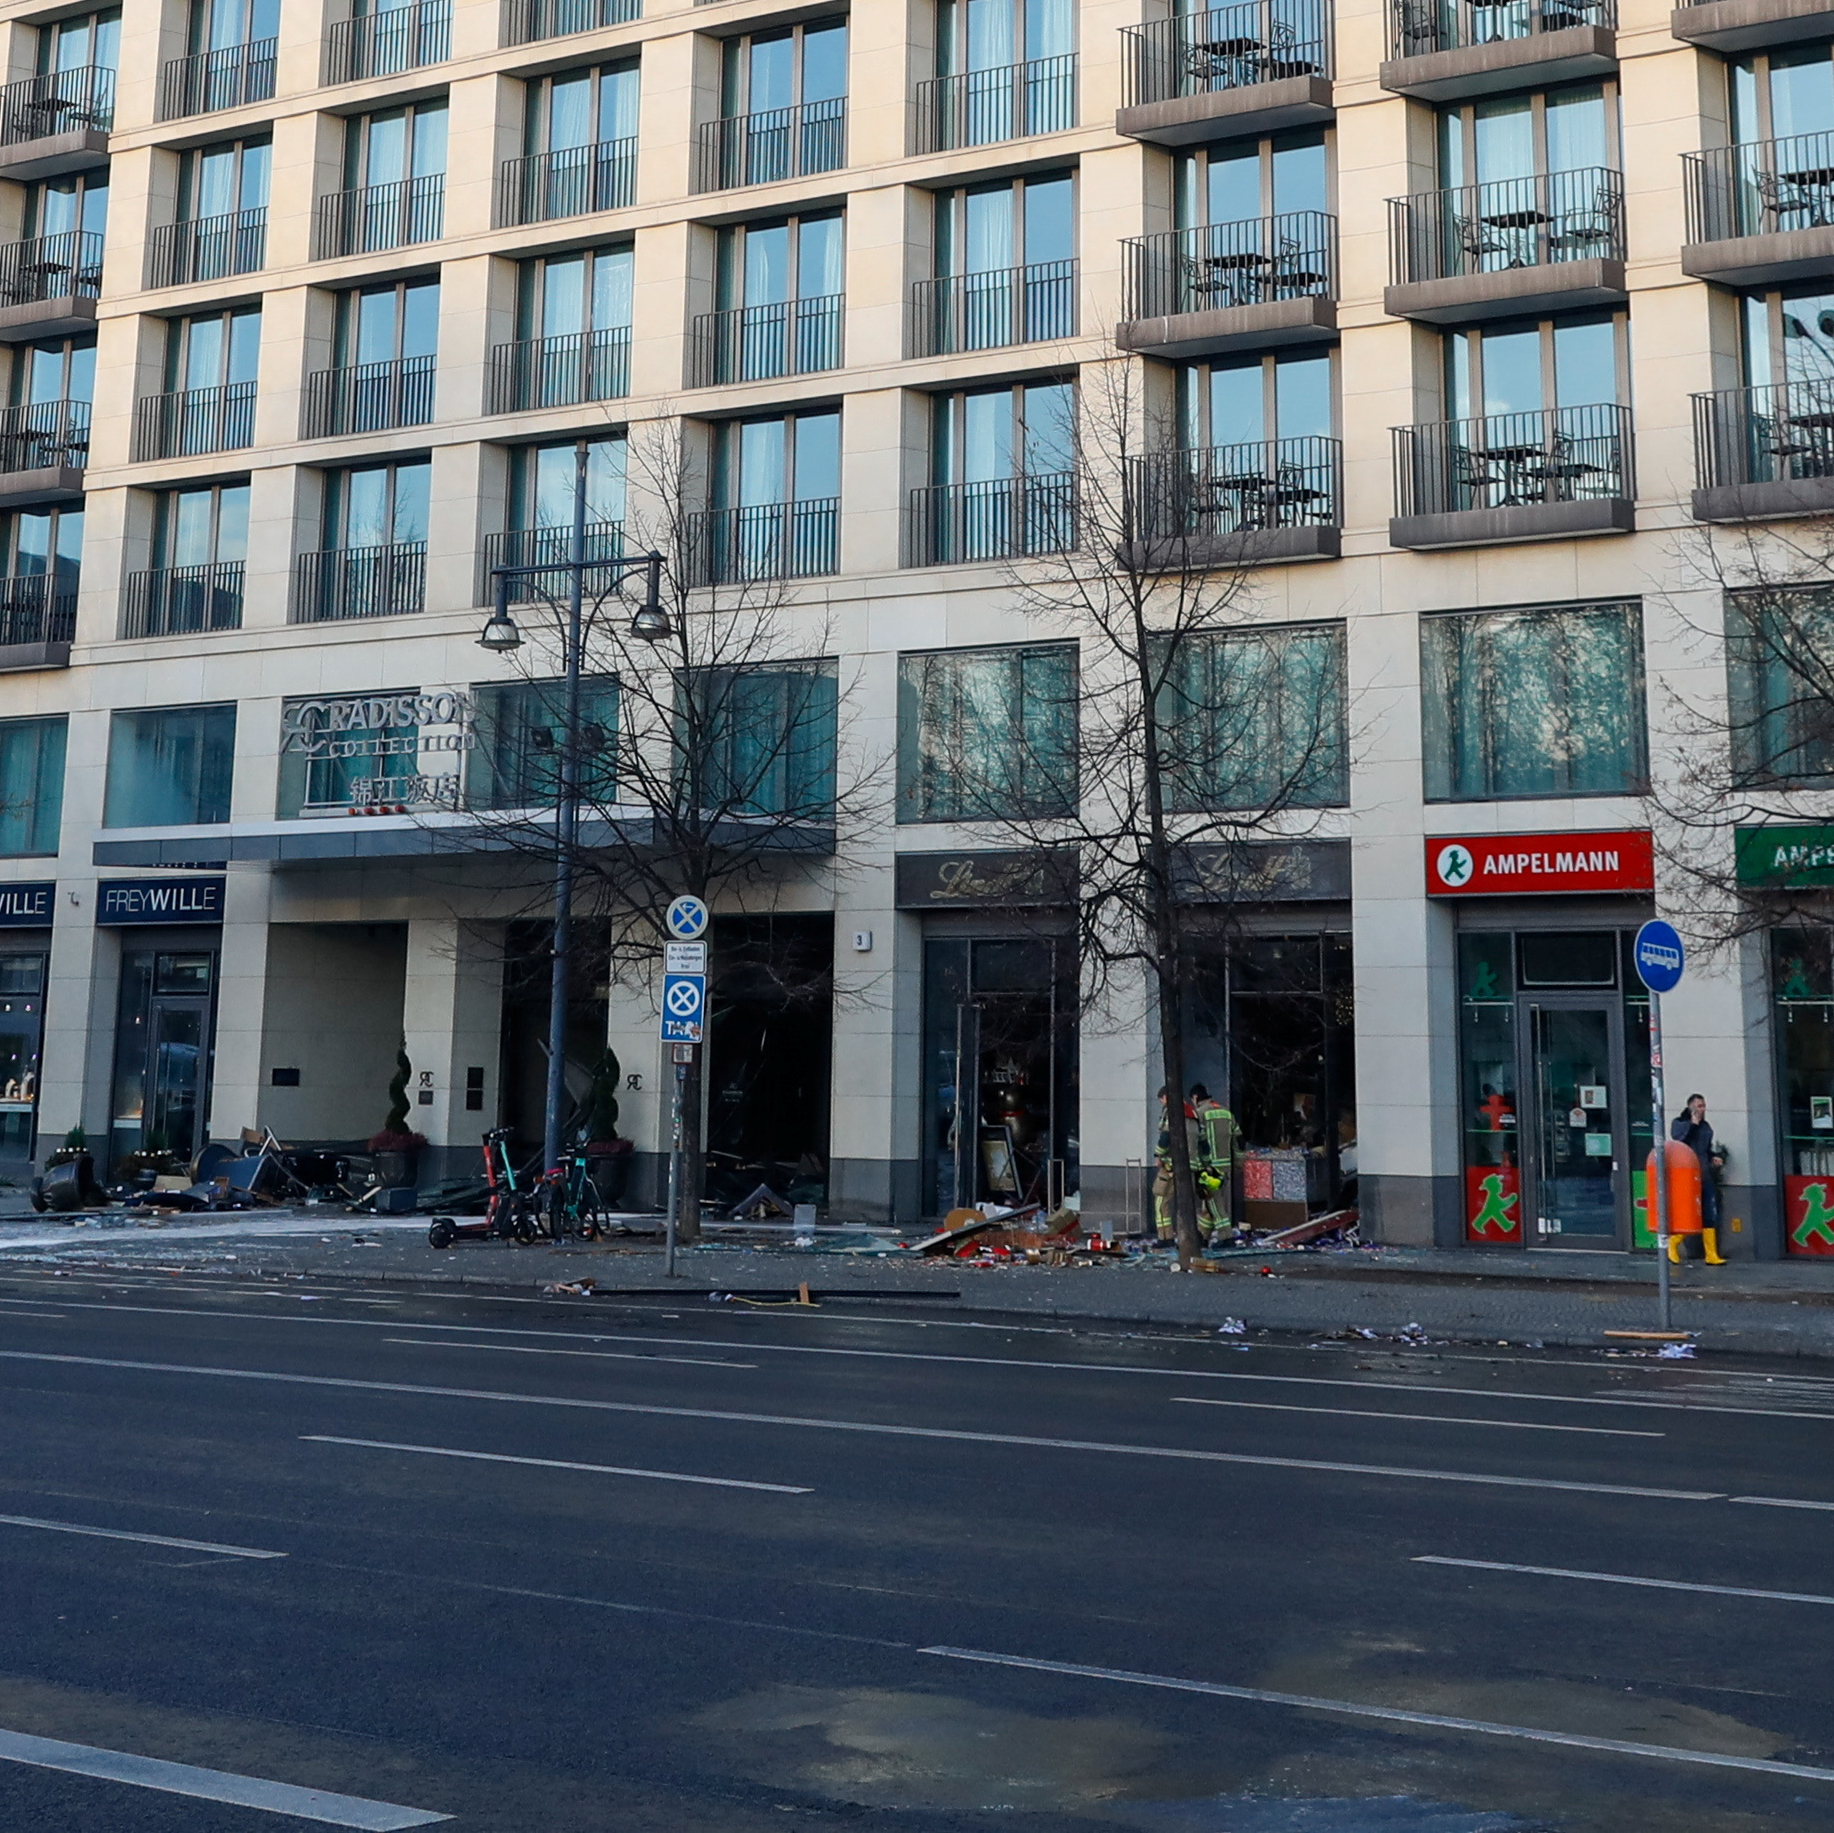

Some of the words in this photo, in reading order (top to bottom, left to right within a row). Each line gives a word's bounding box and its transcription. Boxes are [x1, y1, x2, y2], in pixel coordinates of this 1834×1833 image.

[329, 690, 477, 731] RADISSON
[329, 733, 477, 757] COLLECTION
[1483, 850, 1619, 875] AMPELMANN
[106, 887, 216, 912] FREYWILLE
[857, 934, 863, 946] 3
